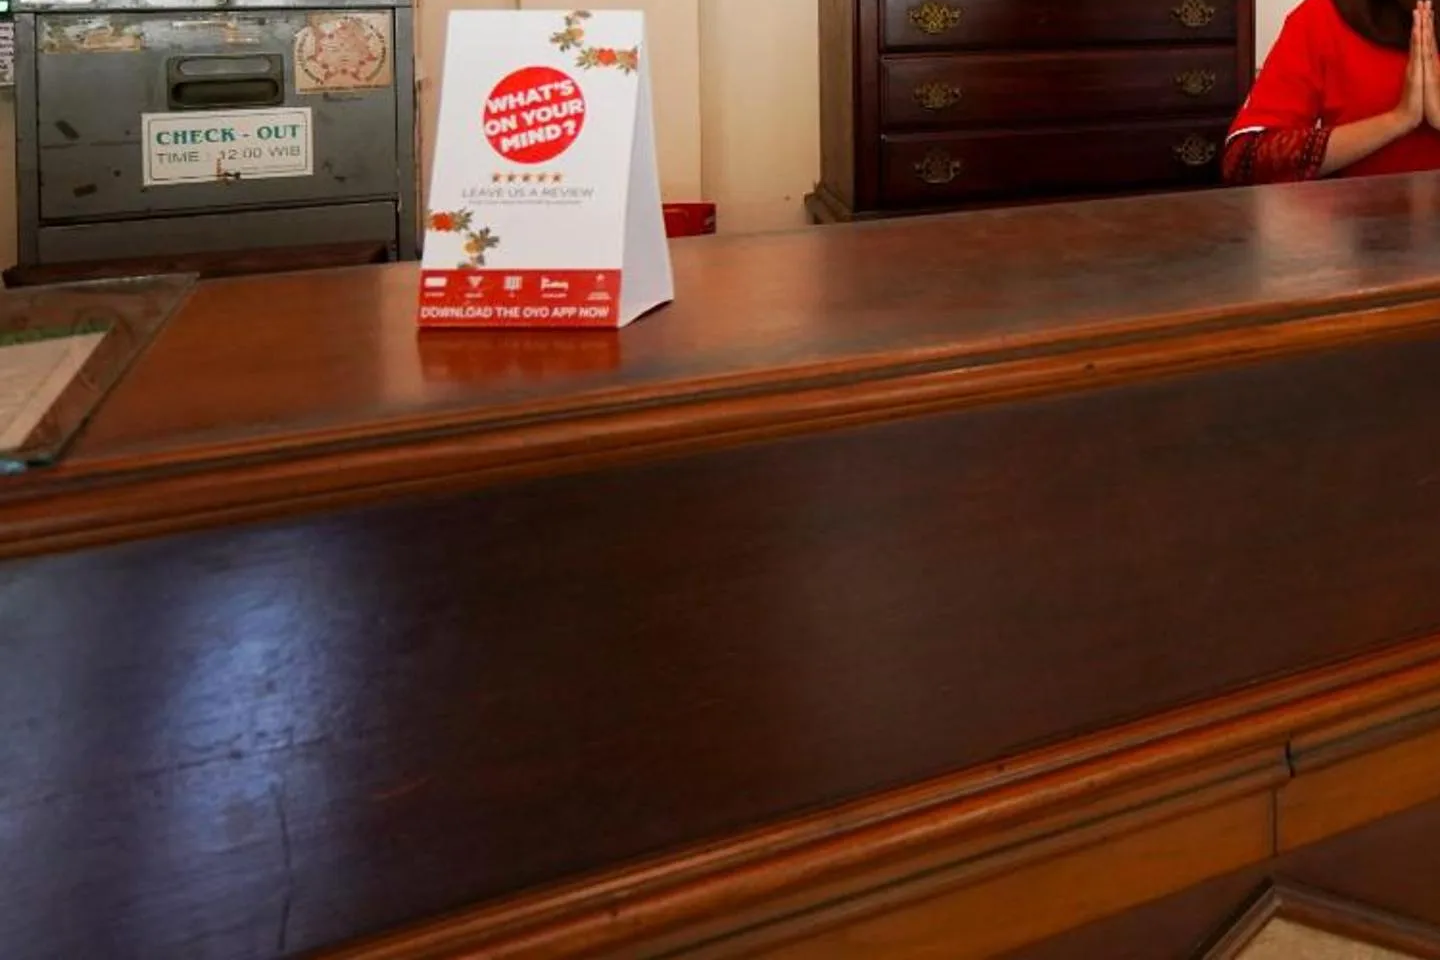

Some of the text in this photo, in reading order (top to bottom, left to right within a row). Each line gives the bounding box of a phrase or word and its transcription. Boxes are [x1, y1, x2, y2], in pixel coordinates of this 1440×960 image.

[486, 79, 575, 114] WHAT'S
[484, 98, 585, 136] ON YOUR
[155, 127, 236, 146] CHECK
[256, 124, 300, 140] OUT
[500, 118, 577, 153] MIND?
[155, 151, 200, 165] TIME
[268, 144, 301, 158] WIB
[461, 187, 503, 198] LEAVE
[541, 187, 596, 198] REVIEW
[420, 306, 610, 319] DOWNLOAD THE OYO APP NOW
